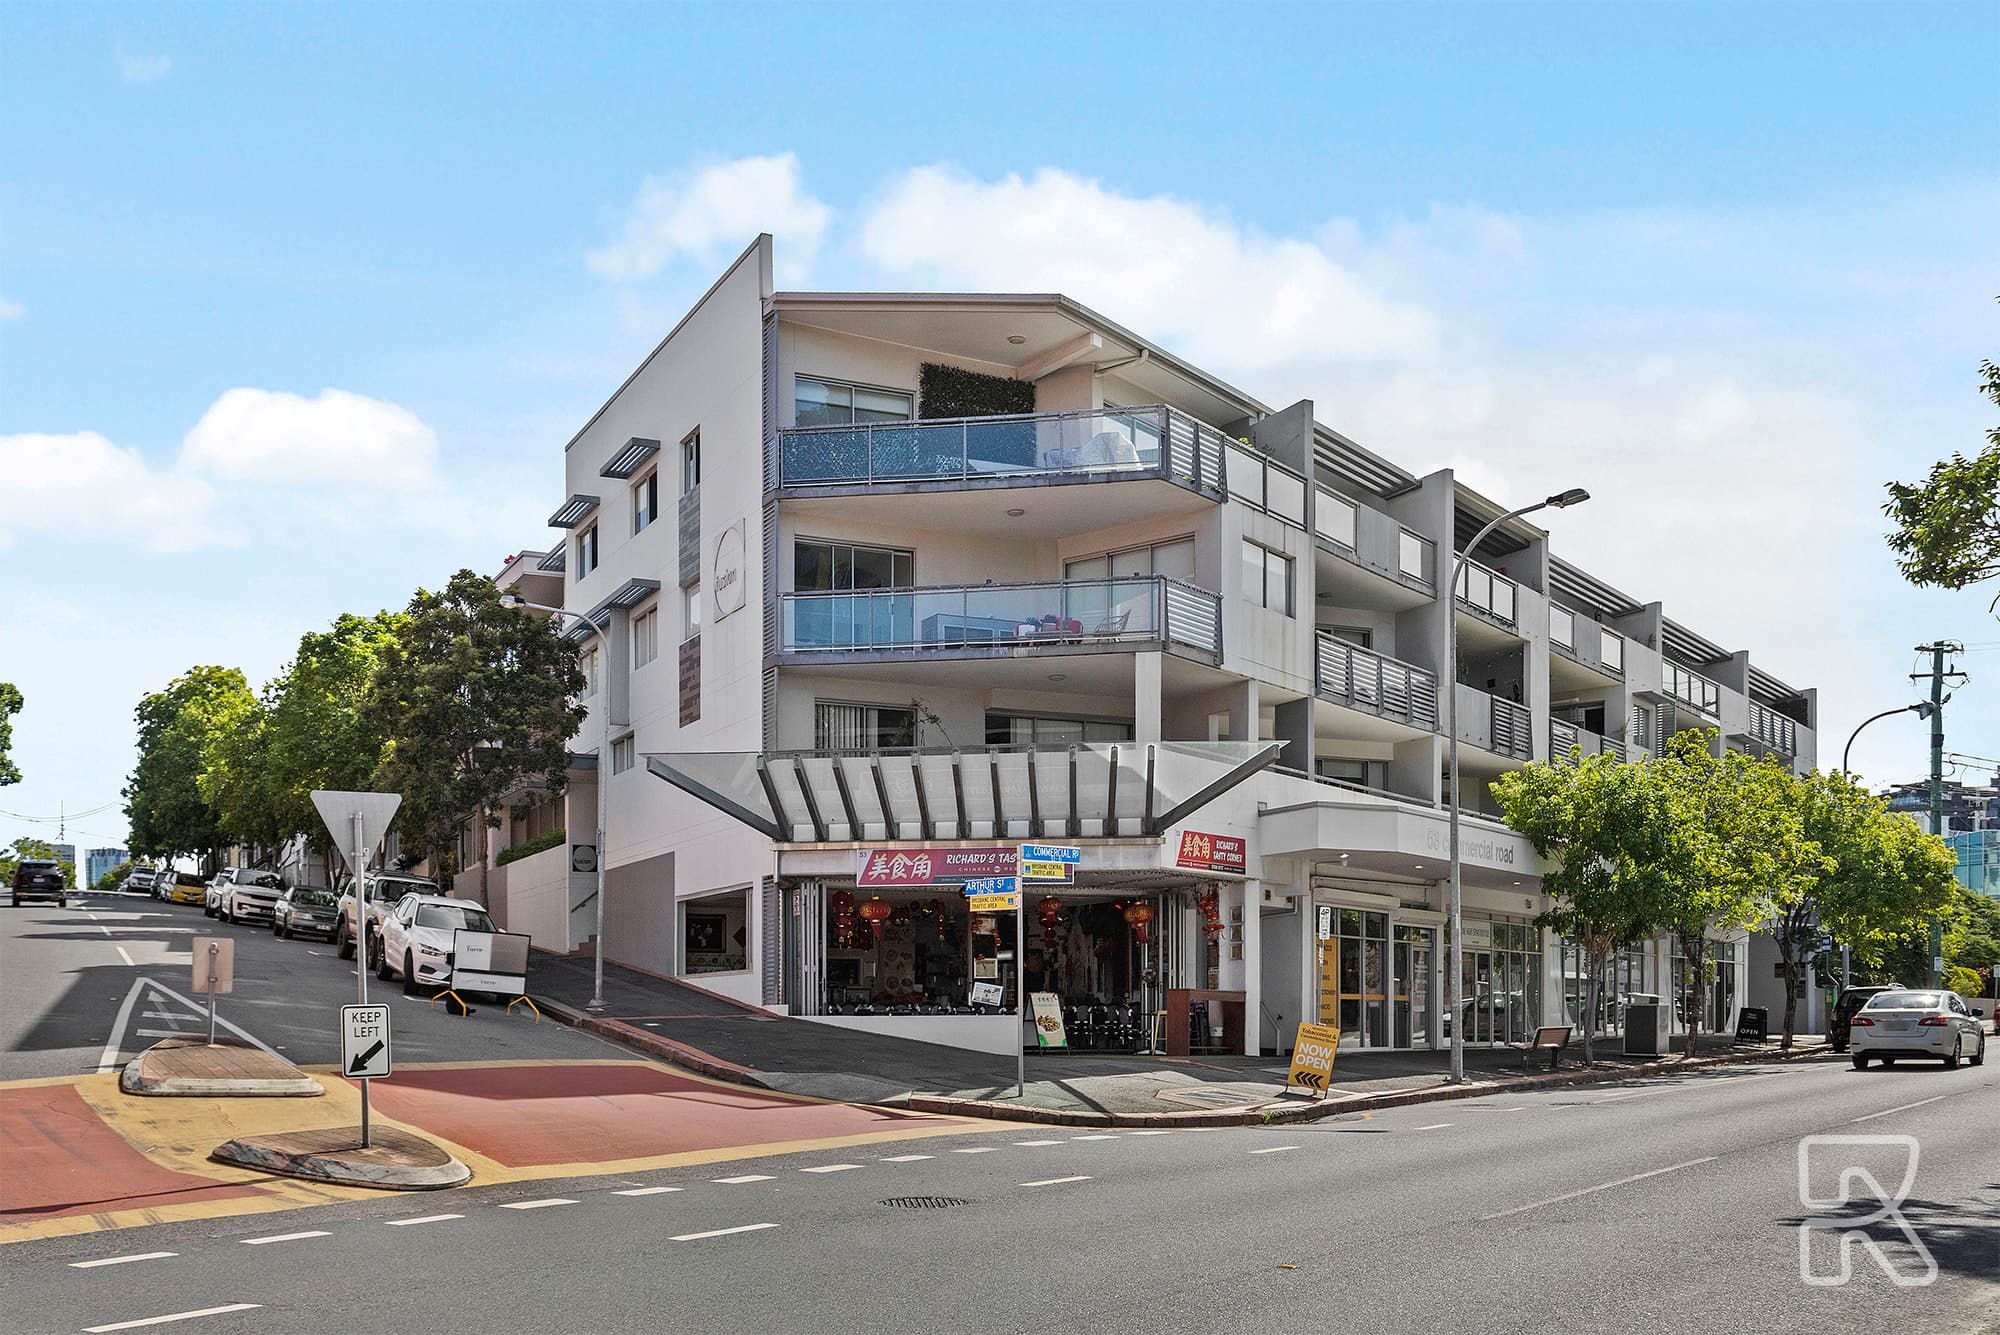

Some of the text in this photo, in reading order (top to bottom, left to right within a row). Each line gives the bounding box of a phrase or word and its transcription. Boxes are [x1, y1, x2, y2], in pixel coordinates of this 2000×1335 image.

[1033, 846, 1071, 858] COMMERCIAL
[1183, 833, 1211, 859] 美食角
[946, 853, 1018, 864] RICHARD'S TAS
[1213, 851, 1227, 861] TASTY
[1496, 844, 1514, 864] road
[868, 852, 932, 880] 美食角
[966, 880, 995, 891] ARTHUR
[351, 1011, 381, 1023] KEEP
[353, 1026, 380, 1038] LEFT
[1740, 1027, 1759, 1035] OPEN
[1298, 1042, 1333, 1059] NOW
[1295, 1054, 1331, 1071] OPEN
